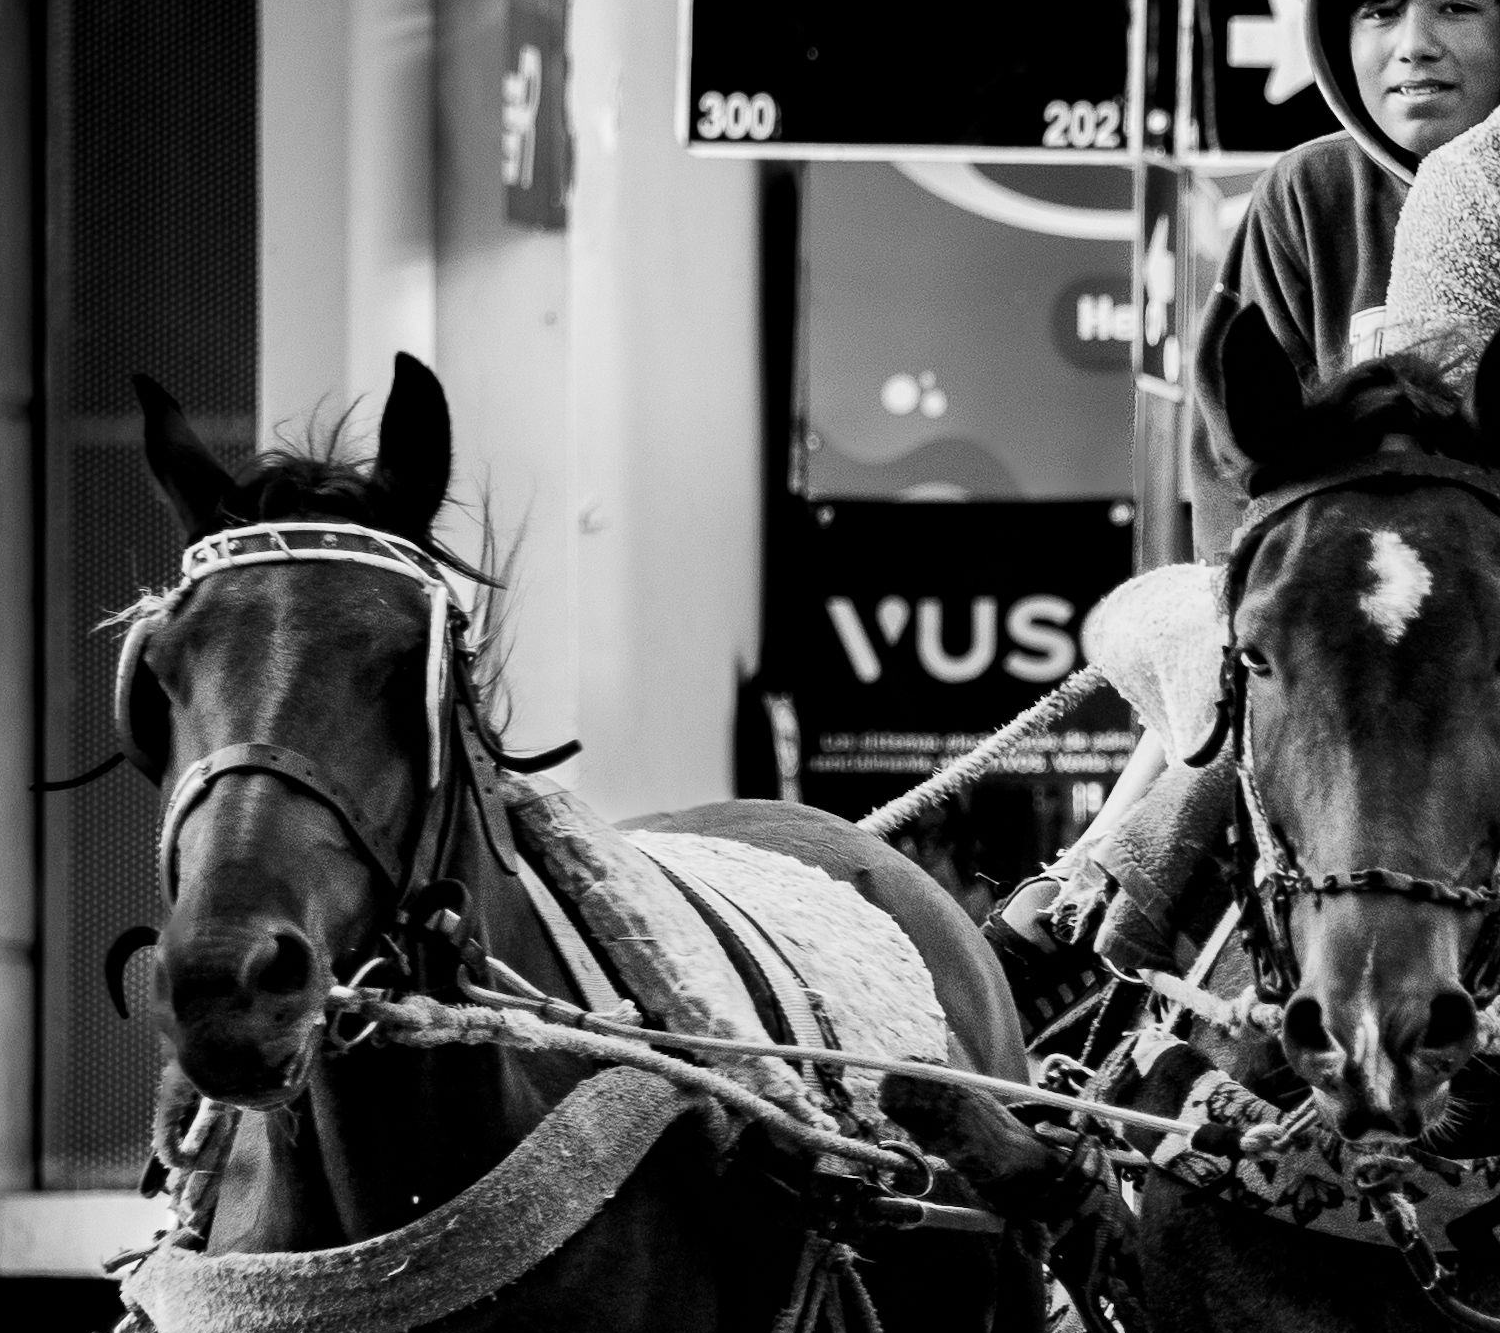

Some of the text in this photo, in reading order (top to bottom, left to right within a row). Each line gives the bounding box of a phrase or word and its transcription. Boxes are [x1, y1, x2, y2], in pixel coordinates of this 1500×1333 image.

[697, 90, 777, 141] 300
[1042, 99, 1121, 148] 202
[1076, 293, 1134, 342] He
[824, 593, 1088, 685] VUS
